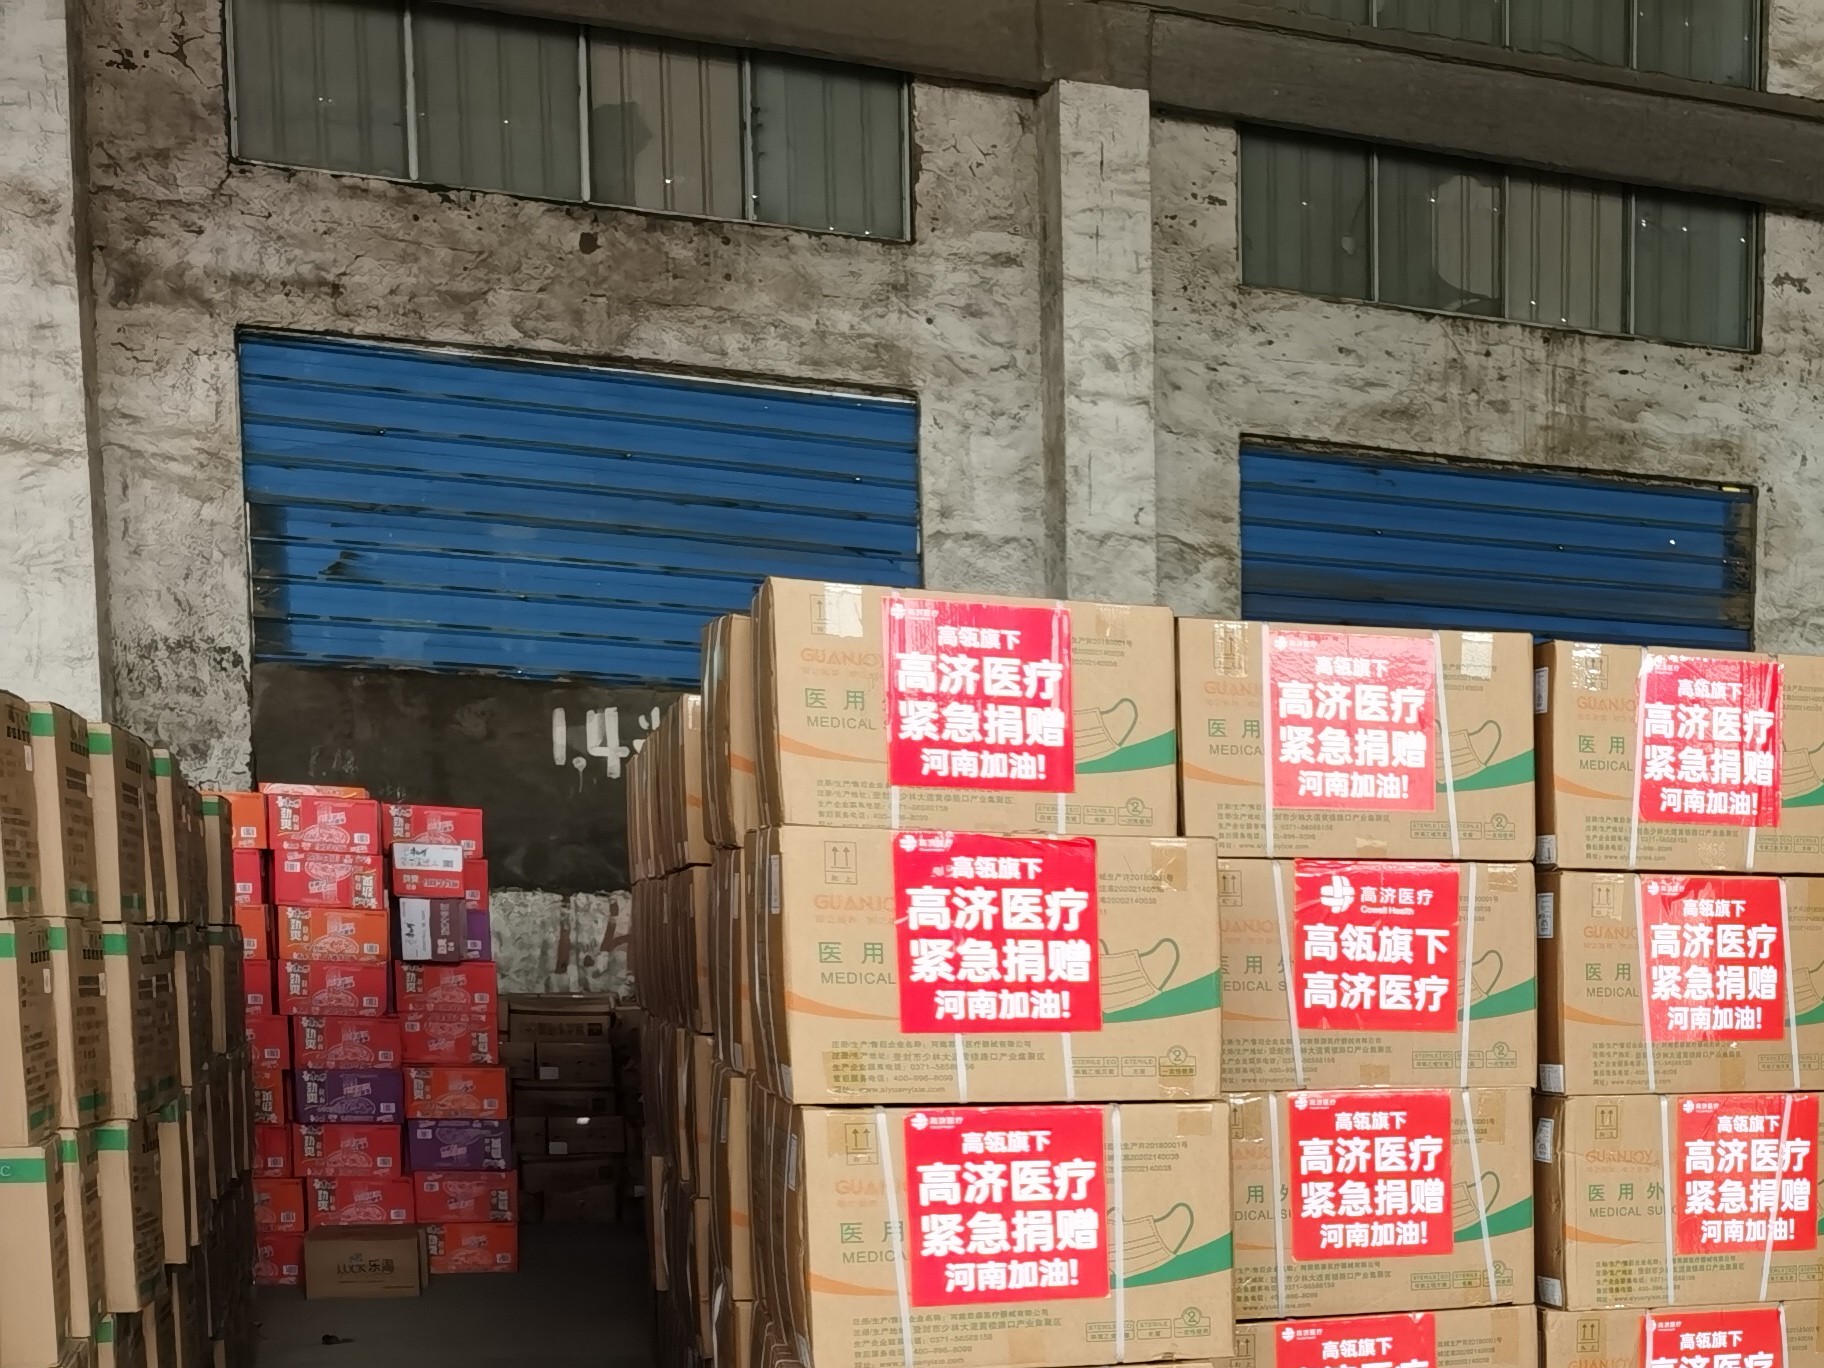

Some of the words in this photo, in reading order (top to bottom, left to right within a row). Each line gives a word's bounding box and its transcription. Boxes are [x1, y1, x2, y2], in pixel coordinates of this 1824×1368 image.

[937, 626, 1021, 648] 高瓴旗下
[896, 653, 1062, 698] 高济医疗
[1315, 656, 1389, 678] 高瓴旗下
[1278, 680, 1426, 724] 高济医疗
[1677, 678, 1743, 699] 高瓴旗下
[807, 716, 877, 730] MEDICAL
[899, 701, 1065, 747] 紧急捐赠
[1644, 702, 1774, 744] 高济医疗
[1279, 726, 1426, 768] 紧急捐赠
[920, 749, 1046, 779] 河南加油!
[1580, 760, 1633, 772] MEDICAL
[1644, 745, 1774, 786] 紧急捐赠
[1298, 770, 1408, 799] 河南加油!
[1659, 788, 1758, 816] 河南加油!
[951, 857, 1043, 880] 高瓴旗下
[906, 887, 1089, 932] 高济医疗
[1360, 887, 1434, 906] 高济医疗
[1388, 906, 1415, 916] Health
[1683, 899, 1746, 917] 高瓴旗下
[1302, 922, 1449, 965] 高瓴旗下
[1650, 923, 1777, 959] 高济医疗
[909, 939, 1090, 982] 紧急捐赠
[820, 970, 896, 984] MEDICAL
[1303, 971, 1449, 1011] 高济医疗
[1652, 964, 1777, 1001] 紧急捐赠
[934, 991, 1070, 1020] 河南加油!
[1586, 987, 1639, 997] MEDICAL
[1667, 1006, 1762, 1031] 河南加油!
[1335, 1111, 1407, 1131] 高瓴旗下
[1717, 1115, 1780, 1133] 高瓴旗下
[961, 1131, 1051, 1154] 高瓴旗下
[1299, 1135, 1443, 1175] 高济医疗
[1685, 1137, 1810, 1174] 高济医疗
[917, 1158, 1096, 1205] 高济医疗
[1301, 1178, 1444, 1219] 紧急捐赠
[1685, 1178, 1810, 1215] 紧急捐赠
[1590, 1206, 1641, 1217] MEDICAL
[920, 1208, 1098, 1257] 紧急捐赠
[1319, 1221, 1428, 1249] 河南加油!
[1701, 1218, 1794, 1244] 河南加油!
[945, 1259, 1078, 1292] 河南加油!
[1322, 1337, 1393, 1359] 高瓴旗下
[1680, 1330, 1743, 1350] 高瓴旗下
